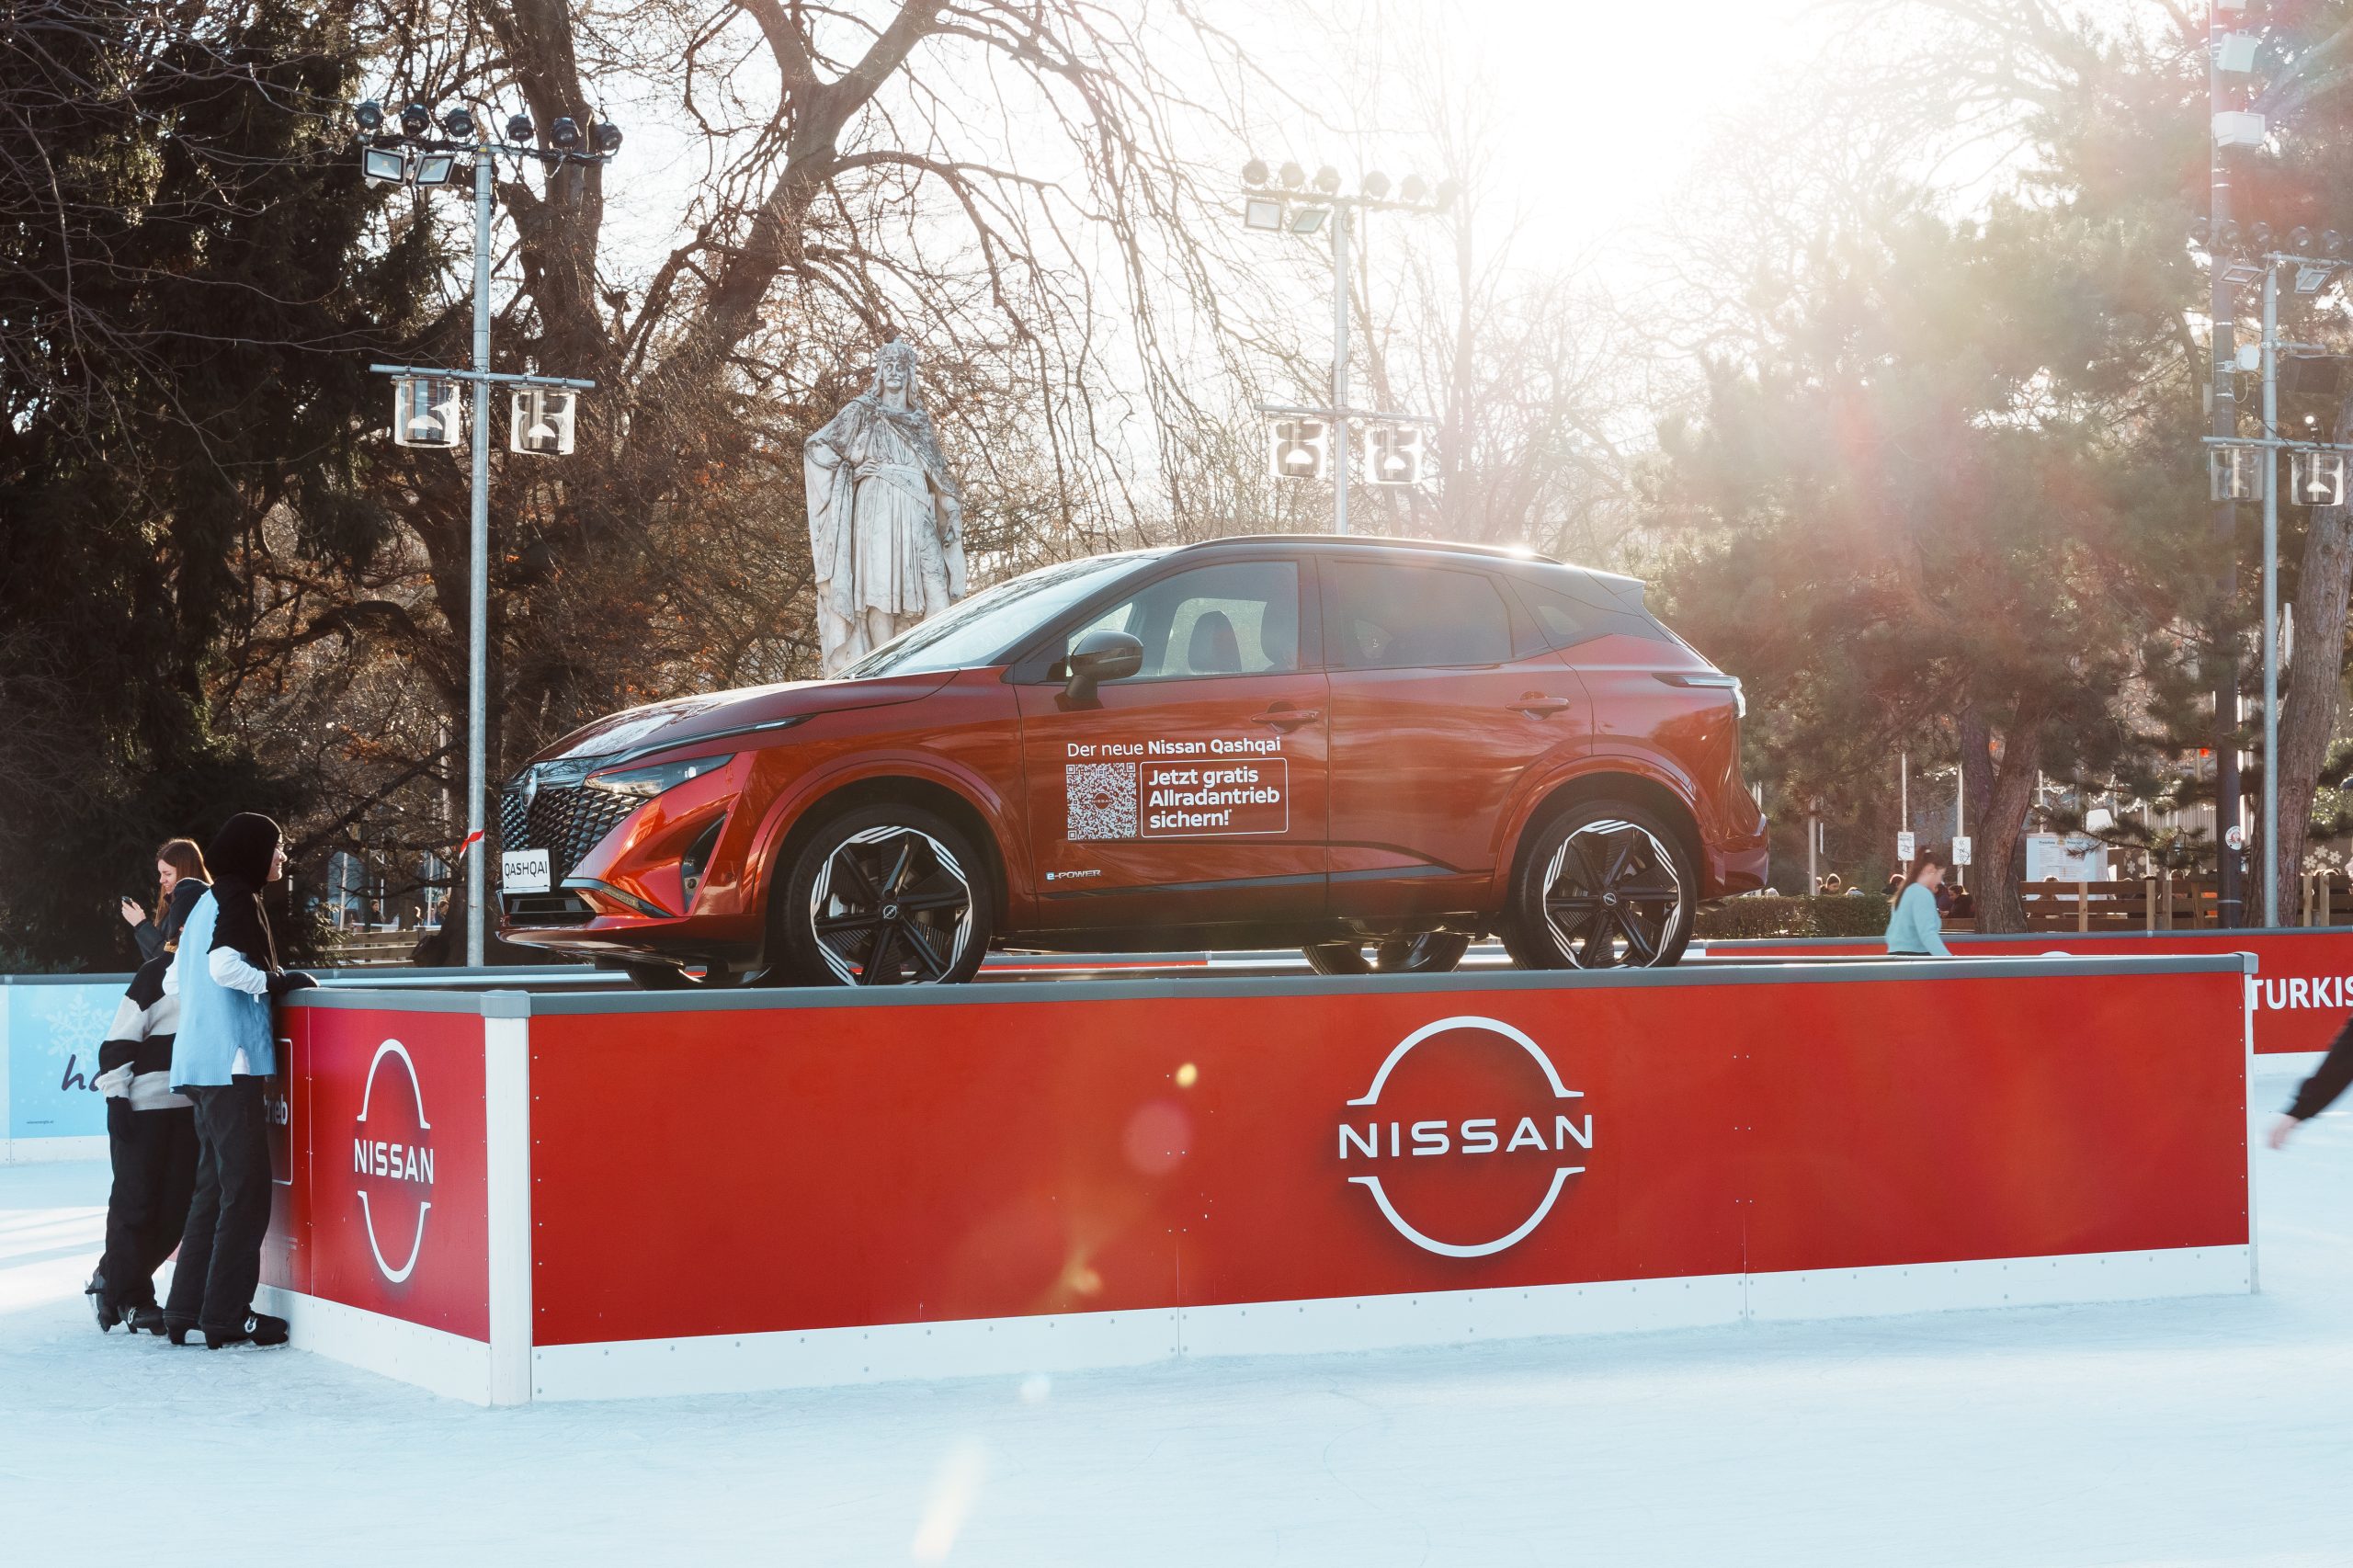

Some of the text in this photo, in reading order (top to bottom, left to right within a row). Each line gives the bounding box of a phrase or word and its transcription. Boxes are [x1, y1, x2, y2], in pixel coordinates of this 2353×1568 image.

[1067, 736, 1280, 757] Der neue Nissan Qashqai
[1149, 766, 1258, 788] Jetzt gratis
[1149, 787, 1279, 807] Allradantrieb
[505, 860, 548, 880] QASHQAI
[1339, 1114, 1593, 1159] NISSAN
[354, 1138, 434, 1185] NISSAN
